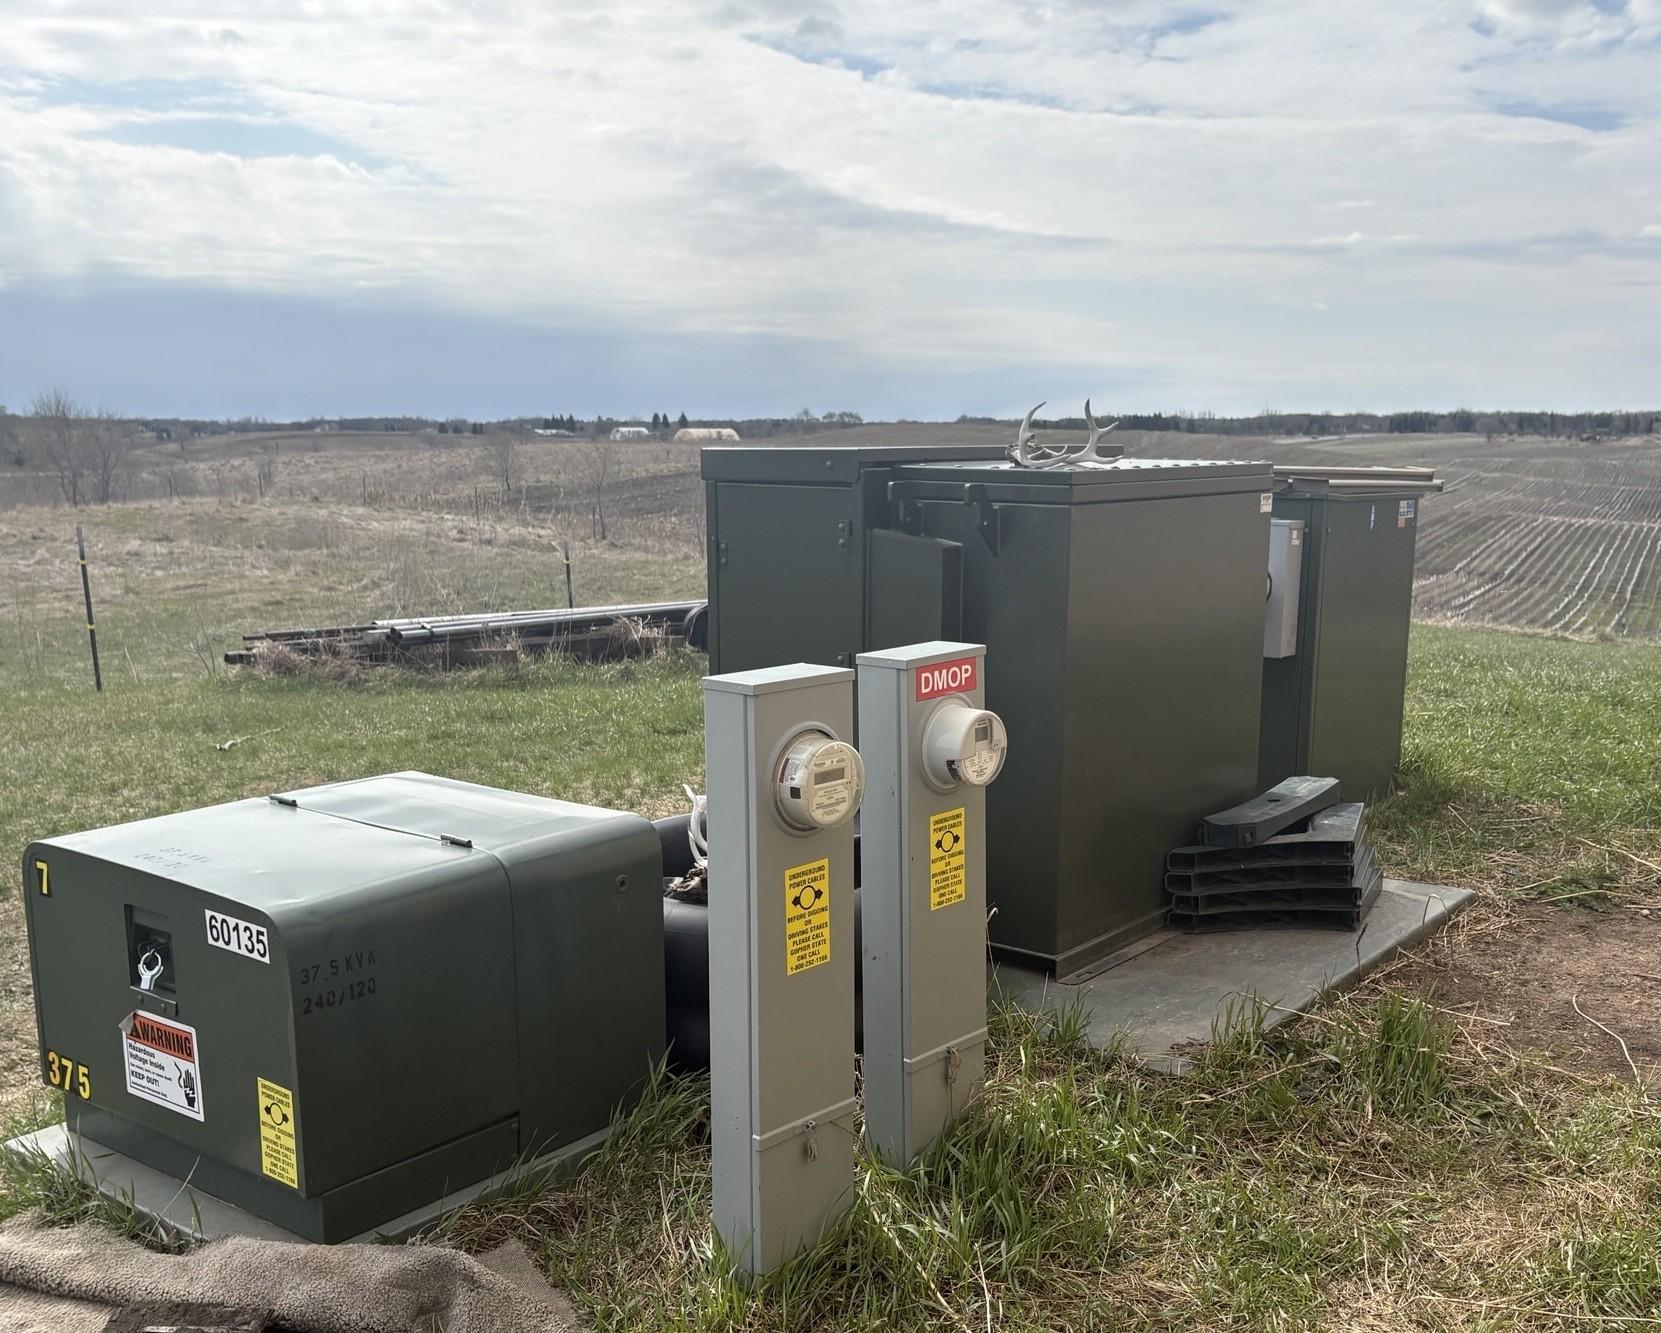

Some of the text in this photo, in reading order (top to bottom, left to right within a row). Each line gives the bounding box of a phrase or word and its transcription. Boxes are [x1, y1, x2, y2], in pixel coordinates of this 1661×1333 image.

[921, 665, 972, 694] DMOP
[36, 860, 50, 895] 7
[789, 865, 825, 880] UNDERGROUND
[789, 874, 825, 889] POWER CABLES
[935, 876, 950, 884] PLEASE
[788, 905, 828, 923] BEFORE DIGGING
[208, 914, 267, 959] 60135
[788, 922, 828, 940] DRIVING STAKES
[793, 931, 824, 946] PLEASE CALL
[791, 938, 826, 955] GOPHER STATE
[797, 949, 820, 961] ONE CALL
[300, 950, 376, 985] 37.5 KVA
[303, 978, 376, 1014] 240/120
[139, 1021, 192, 1057] WARNING
[129, 1041, 155, 1059] Hazardous
[130, 1051, 165, 1071] Voltage Inside
[48, 1051, 90, 1100] 375
[131, 1069, 145, 1081] KEEP
[266, 1144, 292, 1161] PLEASE CALL
